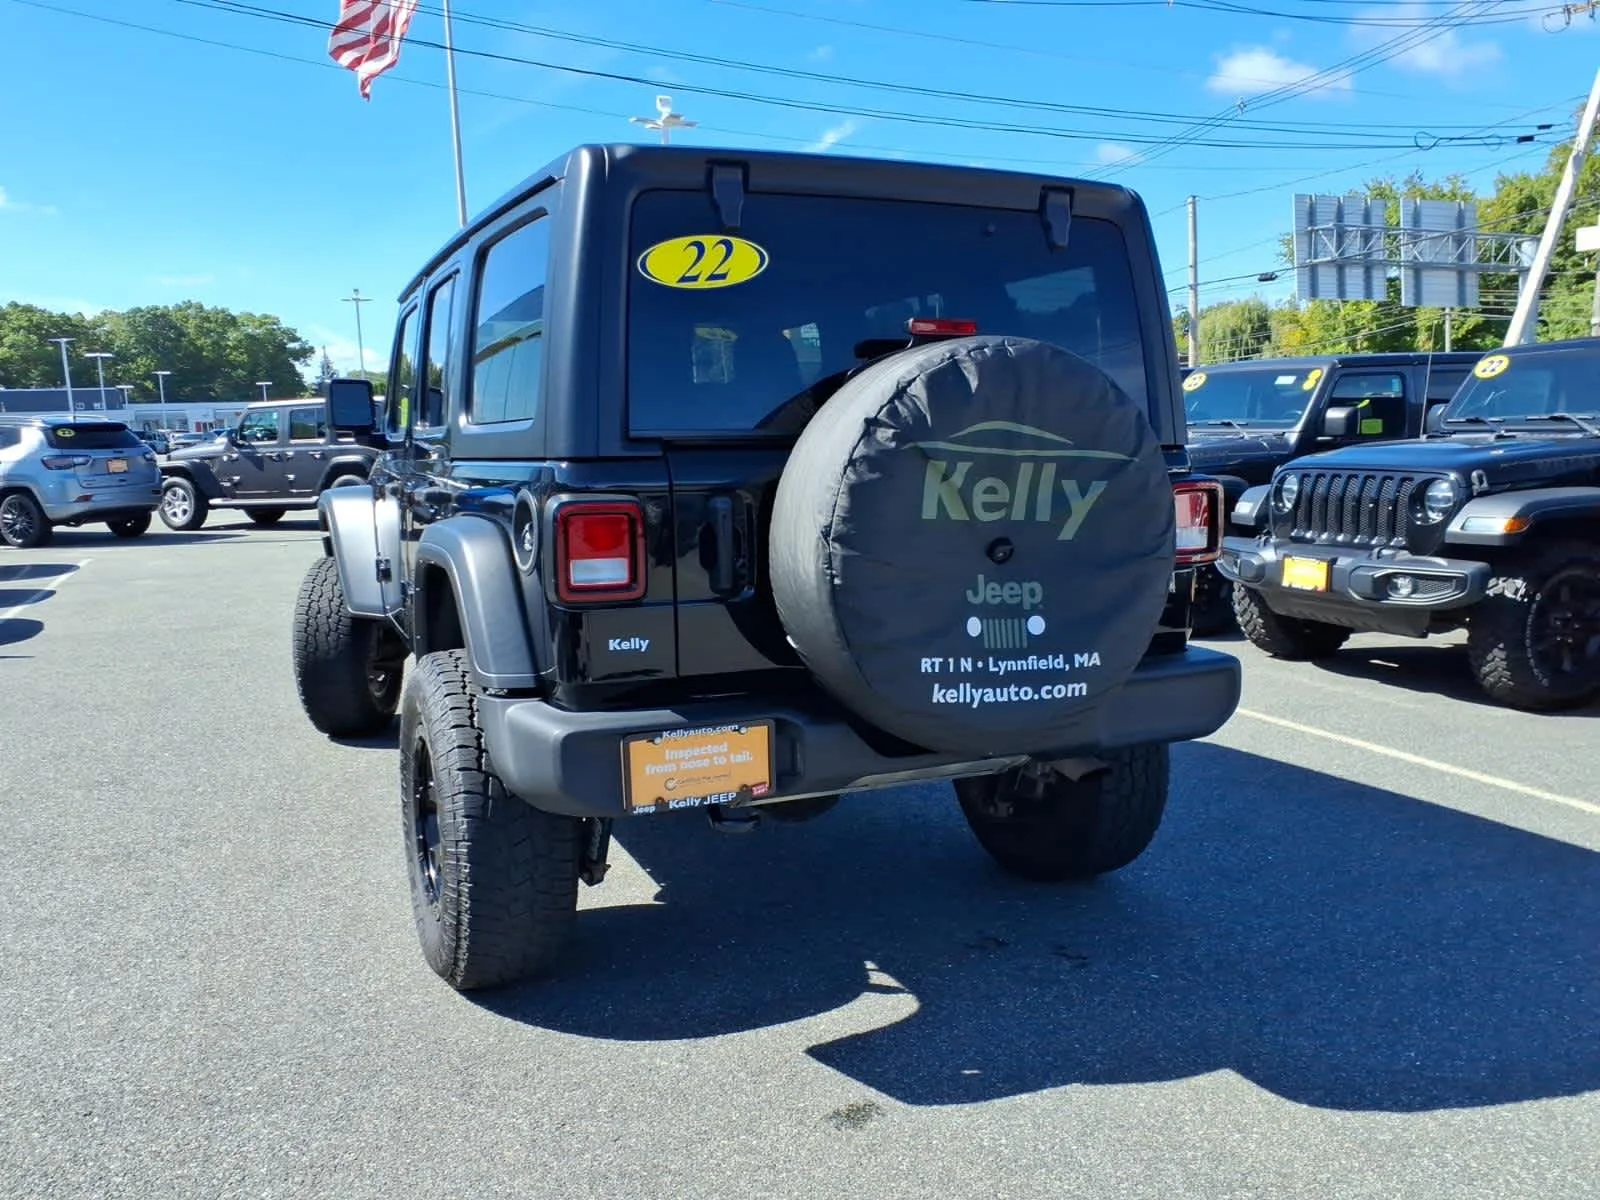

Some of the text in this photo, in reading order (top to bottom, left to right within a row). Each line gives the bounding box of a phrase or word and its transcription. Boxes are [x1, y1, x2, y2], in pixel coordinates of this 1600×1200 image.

[675, 238, 734, 284] 22
[921, 460, 1109, 541] Kelly
[966, 574, 1043, 609] Jeep
[608, 637, 650, 652] Kelly
[920, 652, 1101, 676] RT 1 N Lynnfield, MA
[932, 682, 1088, 708] kellyauto.com
[662, 724, 739, 738] Kellyauto.com
[665, 742, 728, 760] Inspected
[645, 762, 677, 775] from
[680, 758, 710, 769] nose
[713, 755, 727, 765] to
[633, 805, 656, 815] Jeep
[669, 792, 737, 809] Kelly JEEP
